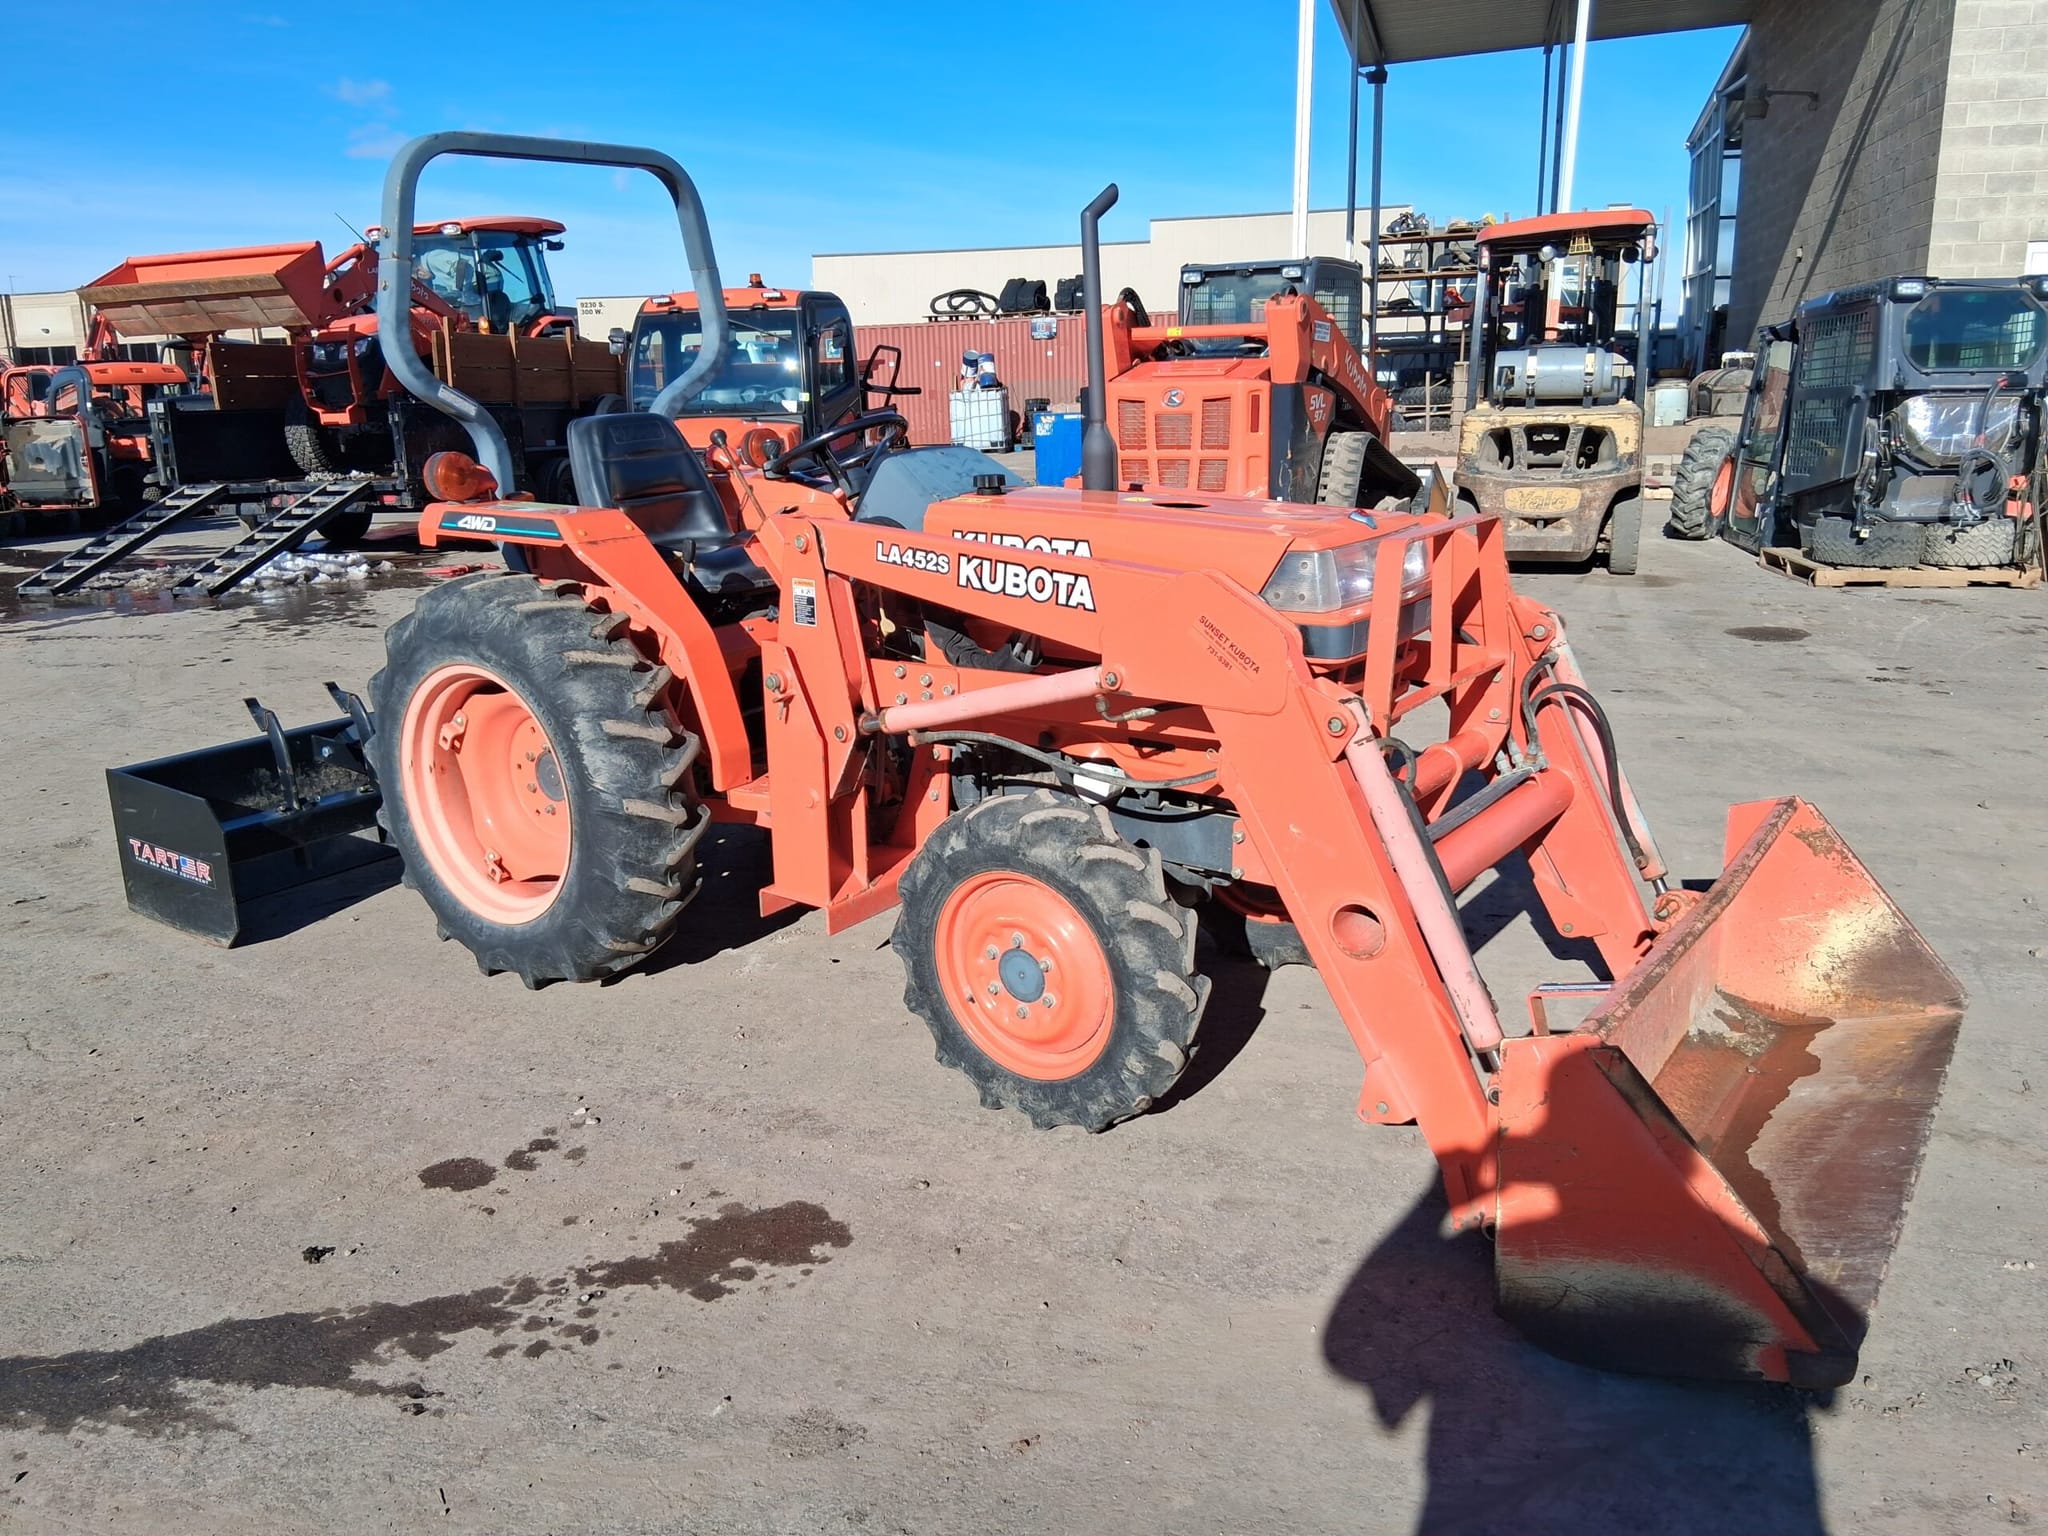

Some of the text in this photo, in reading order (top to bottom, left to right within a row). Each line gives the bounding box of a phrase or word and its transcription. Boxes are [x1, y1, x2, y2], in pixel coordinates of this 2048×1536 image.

[1344, 350, 1367, 399] Kubota
[1309, 392, 1326, 410] SVL
[1519, 490, 1568, 509] Yale
[457, 515, 496, 531] 4WD
[876, 540, 1097, 612] LA452S KUBOTA
[1199, 615, 1230, 644] SUNSET
[1228, 642, 1260, 674] KUBOTA
[129, 838, 212, 882] TARTER
